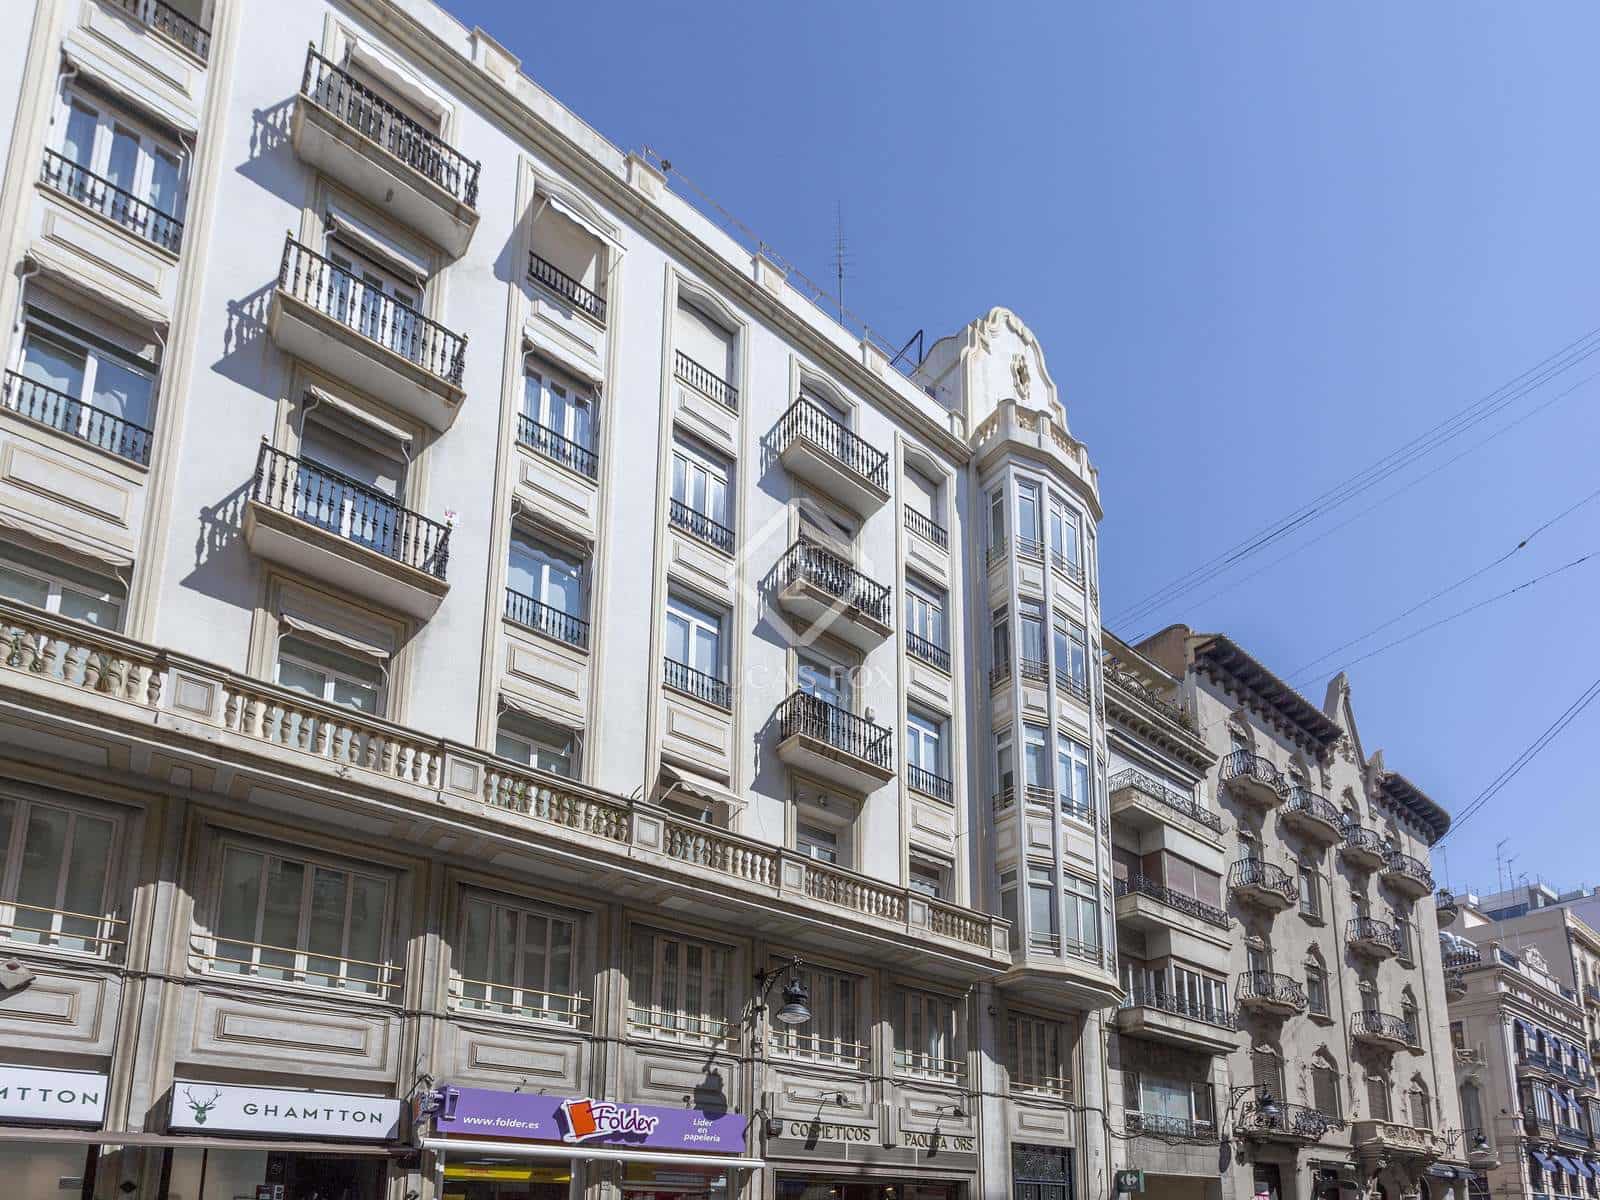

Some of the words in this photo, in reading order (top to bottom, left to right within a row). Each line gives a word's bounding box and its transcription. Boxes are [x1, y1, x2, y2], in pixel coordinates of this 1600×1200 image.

[243, 1102, 383, 1123] GHAMTTON
[463, 1116, 540, 1129] www.folder.es
[587, 1104, 657, 1133] Folder
[790, 1122, 871, 1142] COMETICOS
[953, 1138, 974, 1151] ORS
